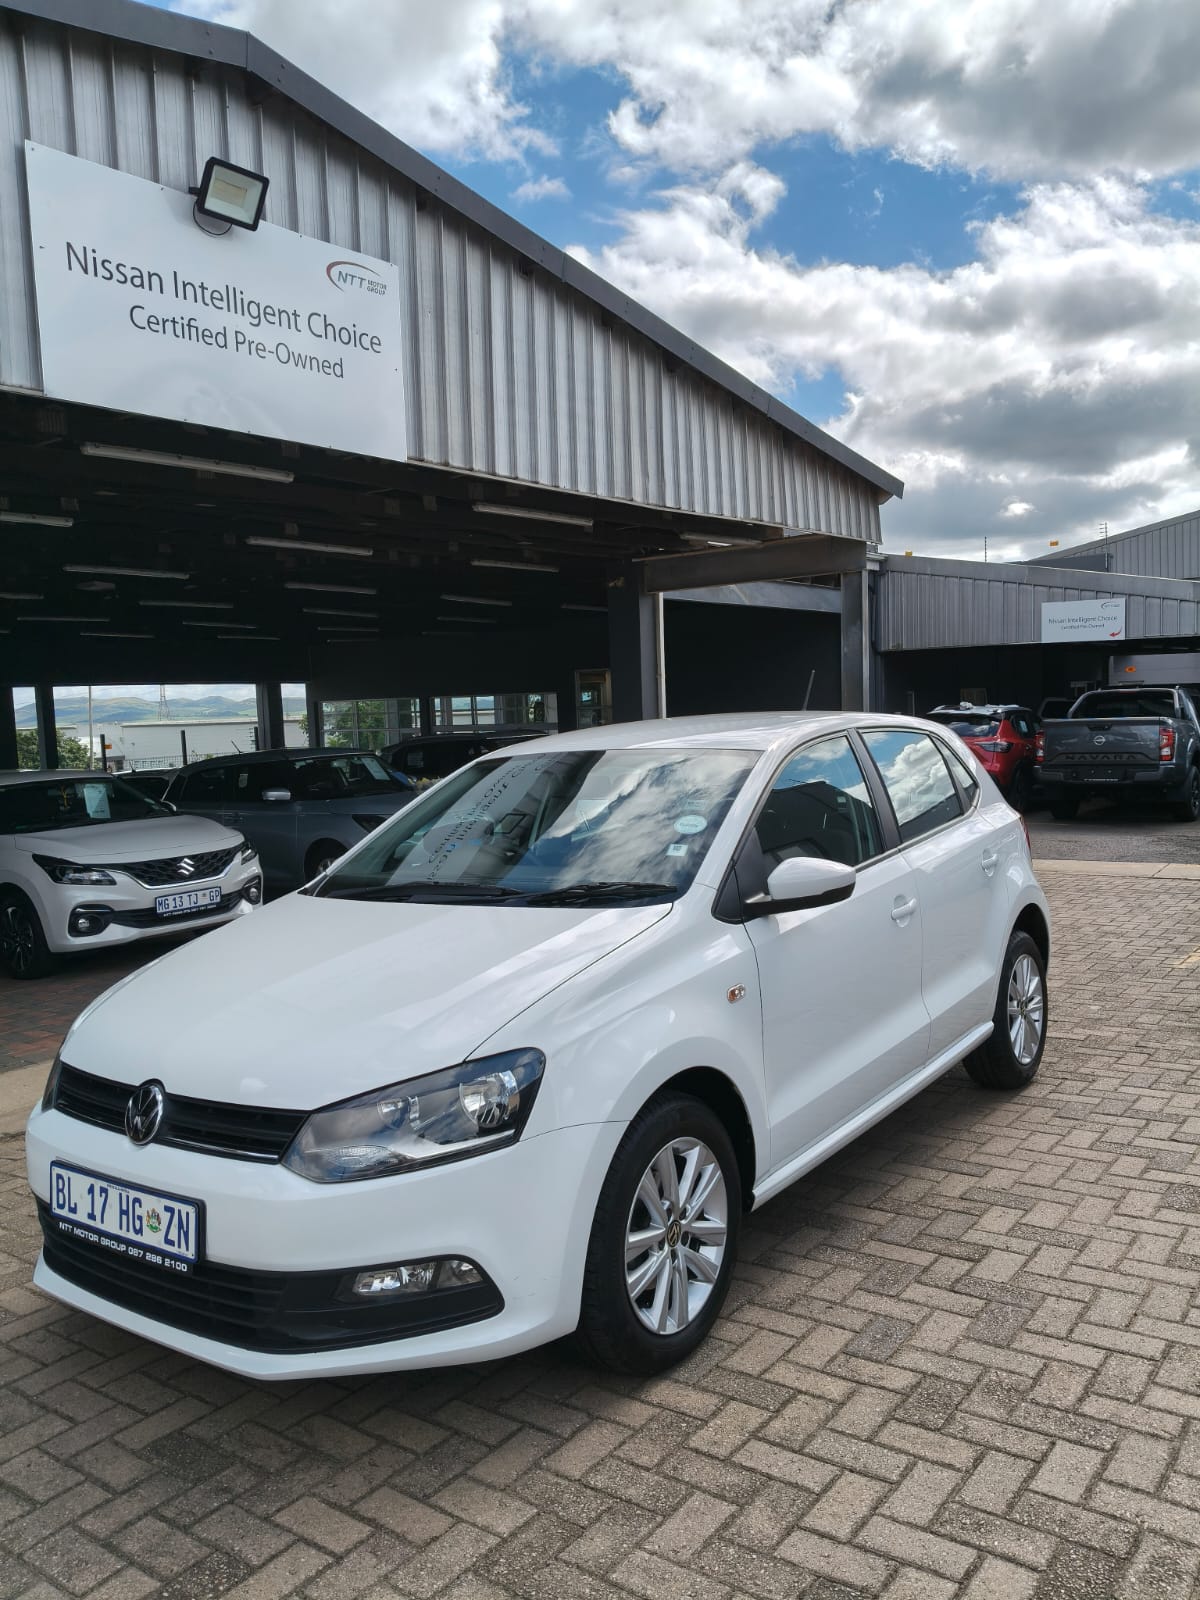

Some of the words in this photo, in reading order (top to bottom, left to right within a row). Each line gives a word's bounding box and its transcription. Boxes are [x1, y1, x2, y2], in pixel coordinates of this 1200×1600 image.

[337, 270, 367, 288] NTT
[366, 286, 386, 295] GROUP
[367, 279, 387, 290] MOTOR
[66, 241, 164, 294] Nissan
[173, 271, 301, 333] Intelligent
[307, 312, 382, 354] Choice
[129, 304, 228, 350] Certified
[234, 330, 345, 379] Pre-Owned
[157, 898, 170, 911] MG
[172, 895, 184, 908] 13
[187, 893, 199, 905] TJ
[209, 889, 220, 902] GP
[55, 1173, 77, 1215] BL
[87, 1183, 109, 1224] 17
[118, 1192, 143, 1237] HG
[163, 1204, 190, 1251] ZN
[58, 1221, 73, 1232] NTT
[73, 1226, 99, 1243] MOTOR
[100, 1236, 127, 1251] GROUP
[164, 1258, 188, 1272] 2100
